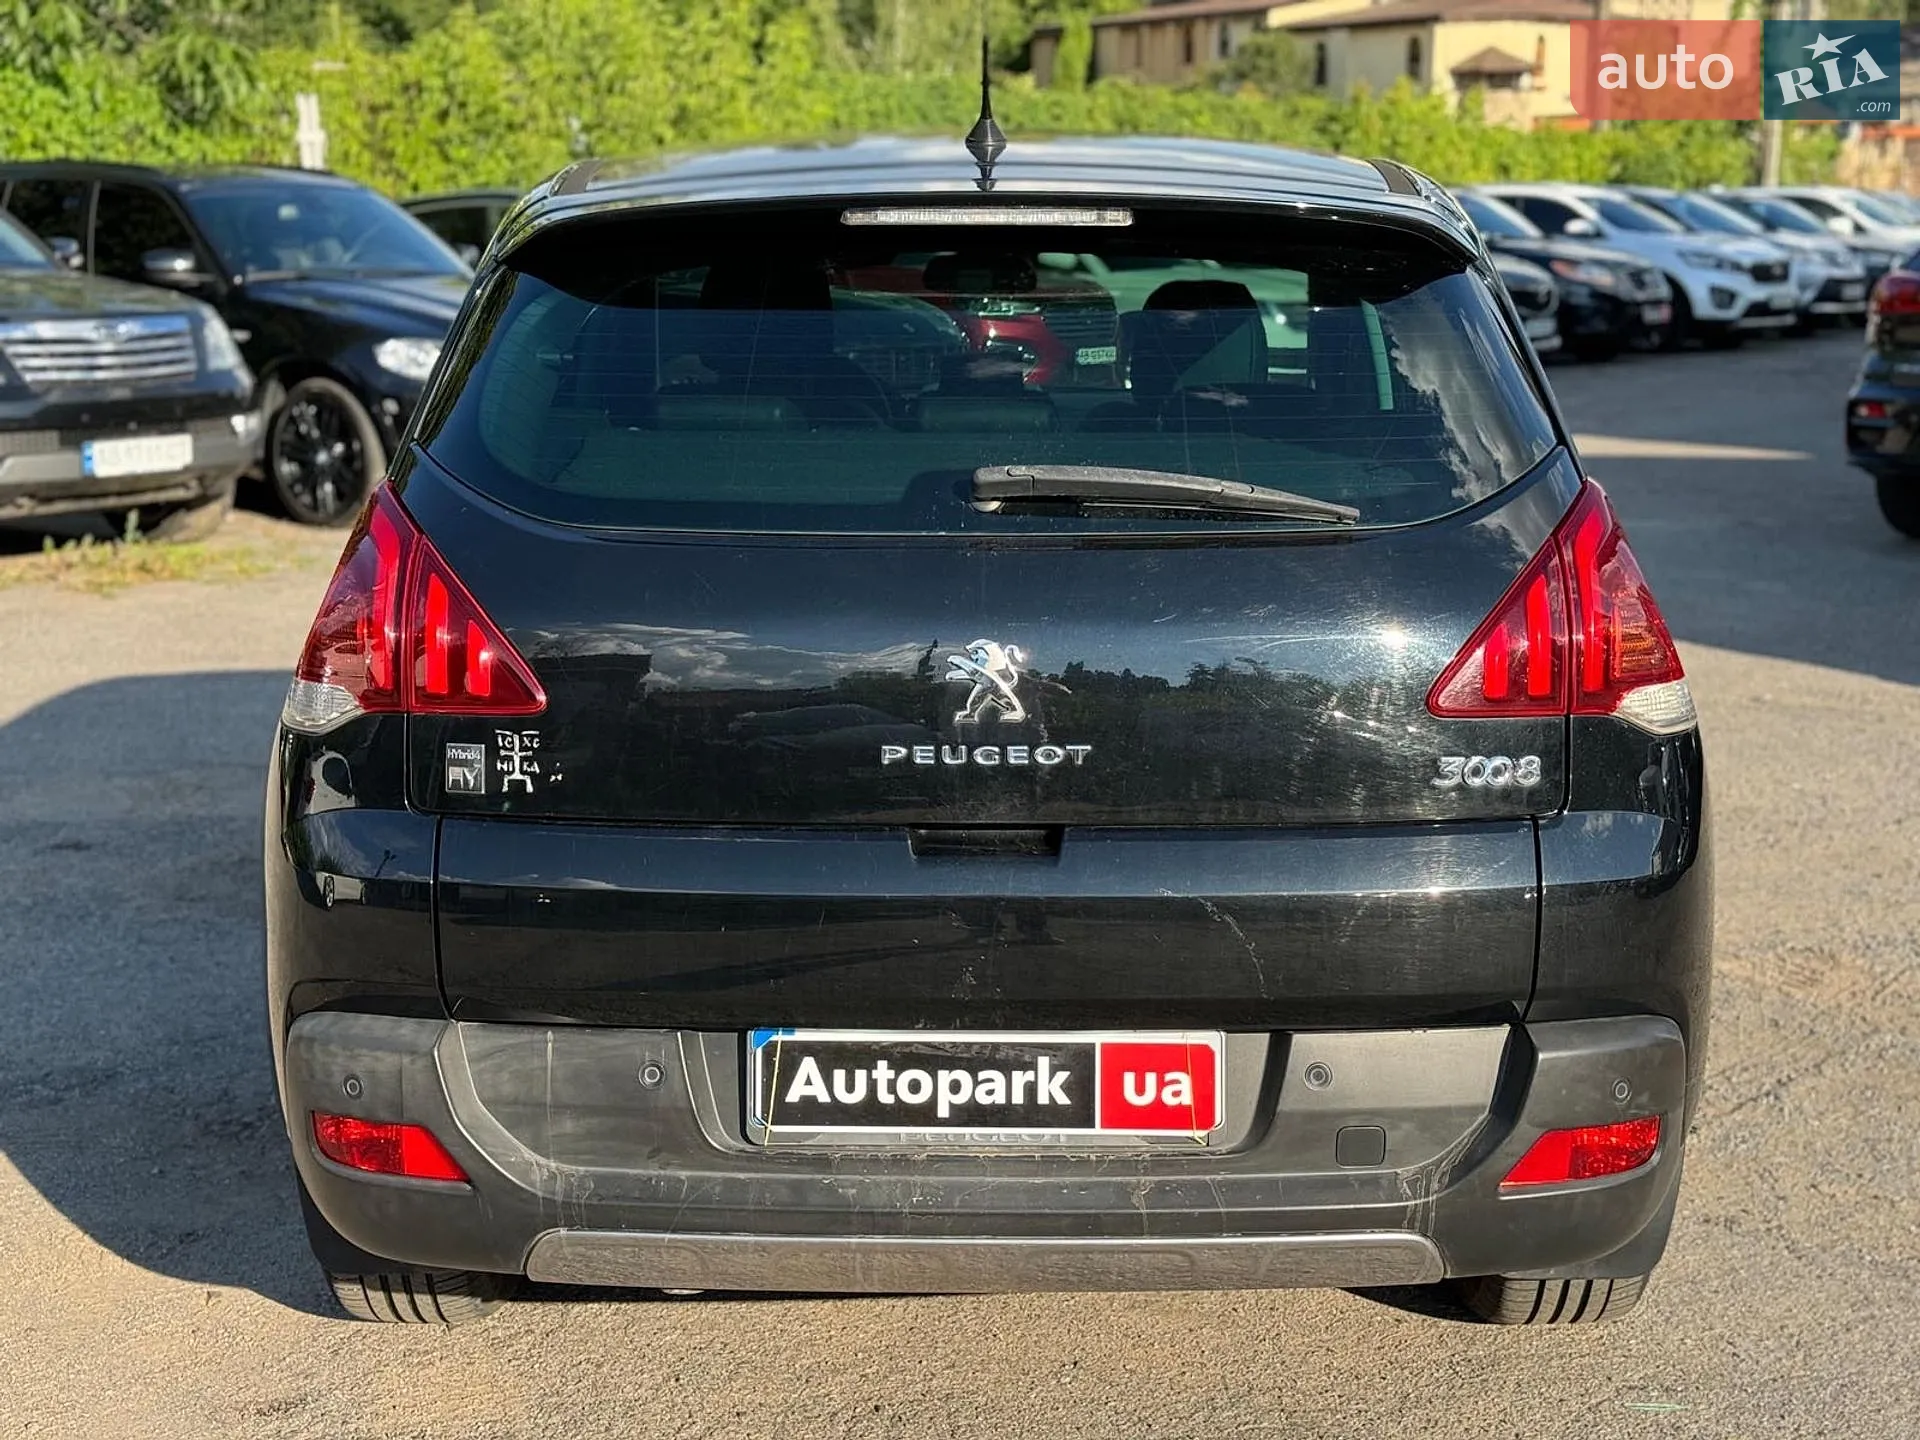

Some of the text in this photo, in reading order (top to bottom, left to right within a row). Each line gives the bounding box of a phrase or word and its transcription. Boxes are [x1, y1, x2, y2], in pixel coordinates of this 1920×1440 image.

[881, 745, 1092, 765] PEUGEOT
[1431, 755, 1541, 787] 3008
[785, 1056, 1192, 1117] Autopark ua
